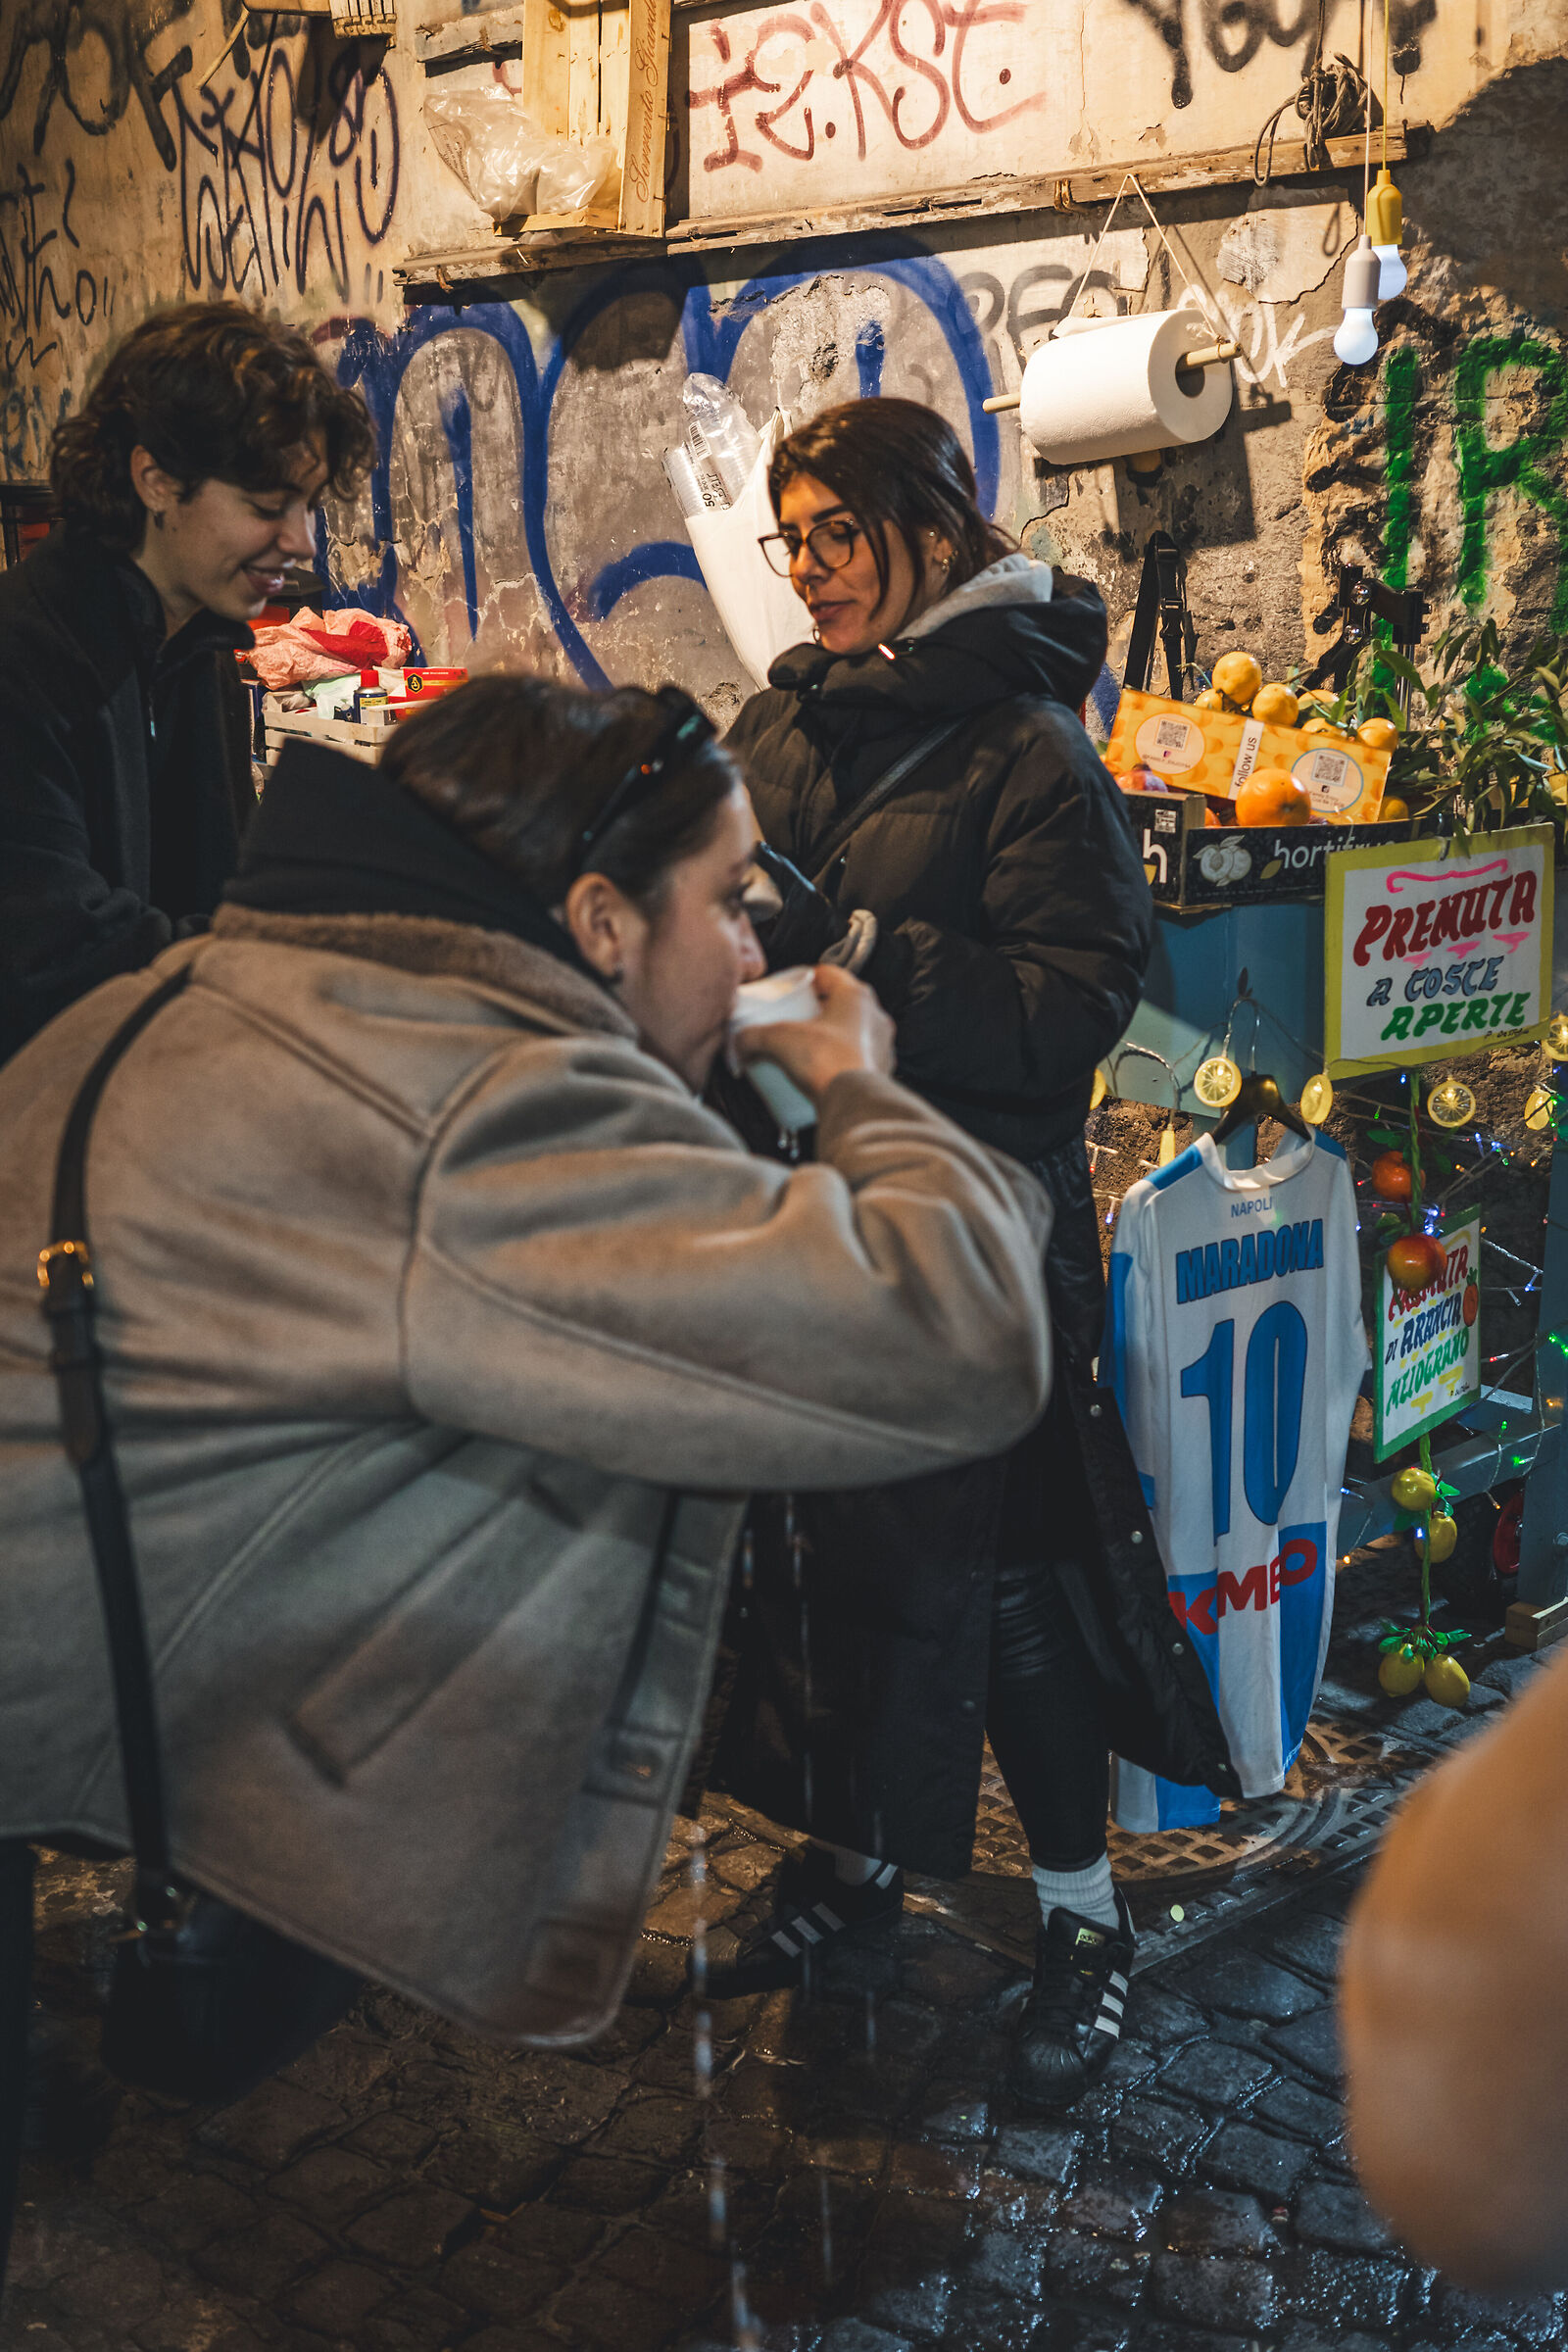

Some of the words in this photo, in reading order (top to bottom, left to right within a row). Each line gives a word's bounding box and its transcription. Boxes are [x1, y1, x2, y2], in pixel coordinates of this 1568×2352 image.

[629, 90, 655, 203] Sorrento
[702, 493, 715, 507] 50
[1235, 754, 1253, 788] follow
[1248, 736, 1257, 752] us
[1353, 870, 1538, 966] PREMUTA
[1366, 977, 1393, 1006] A
[1404, 956, 1504, 1003] COSCE
[1380, 992, 1531, 1041] APERTE
[1230, 1196, 1273, 1218] NAPOLI
[1175, 1218, 1324, 1305] MARADONA
[1384, 1338, 1398, 1365] DI
[1400, 1292, 1462, 1359] ARANCIA
[1385, 1326, 1470, 1417] MELOGRANO
[1181, 1300, 1308, 1547] 10
